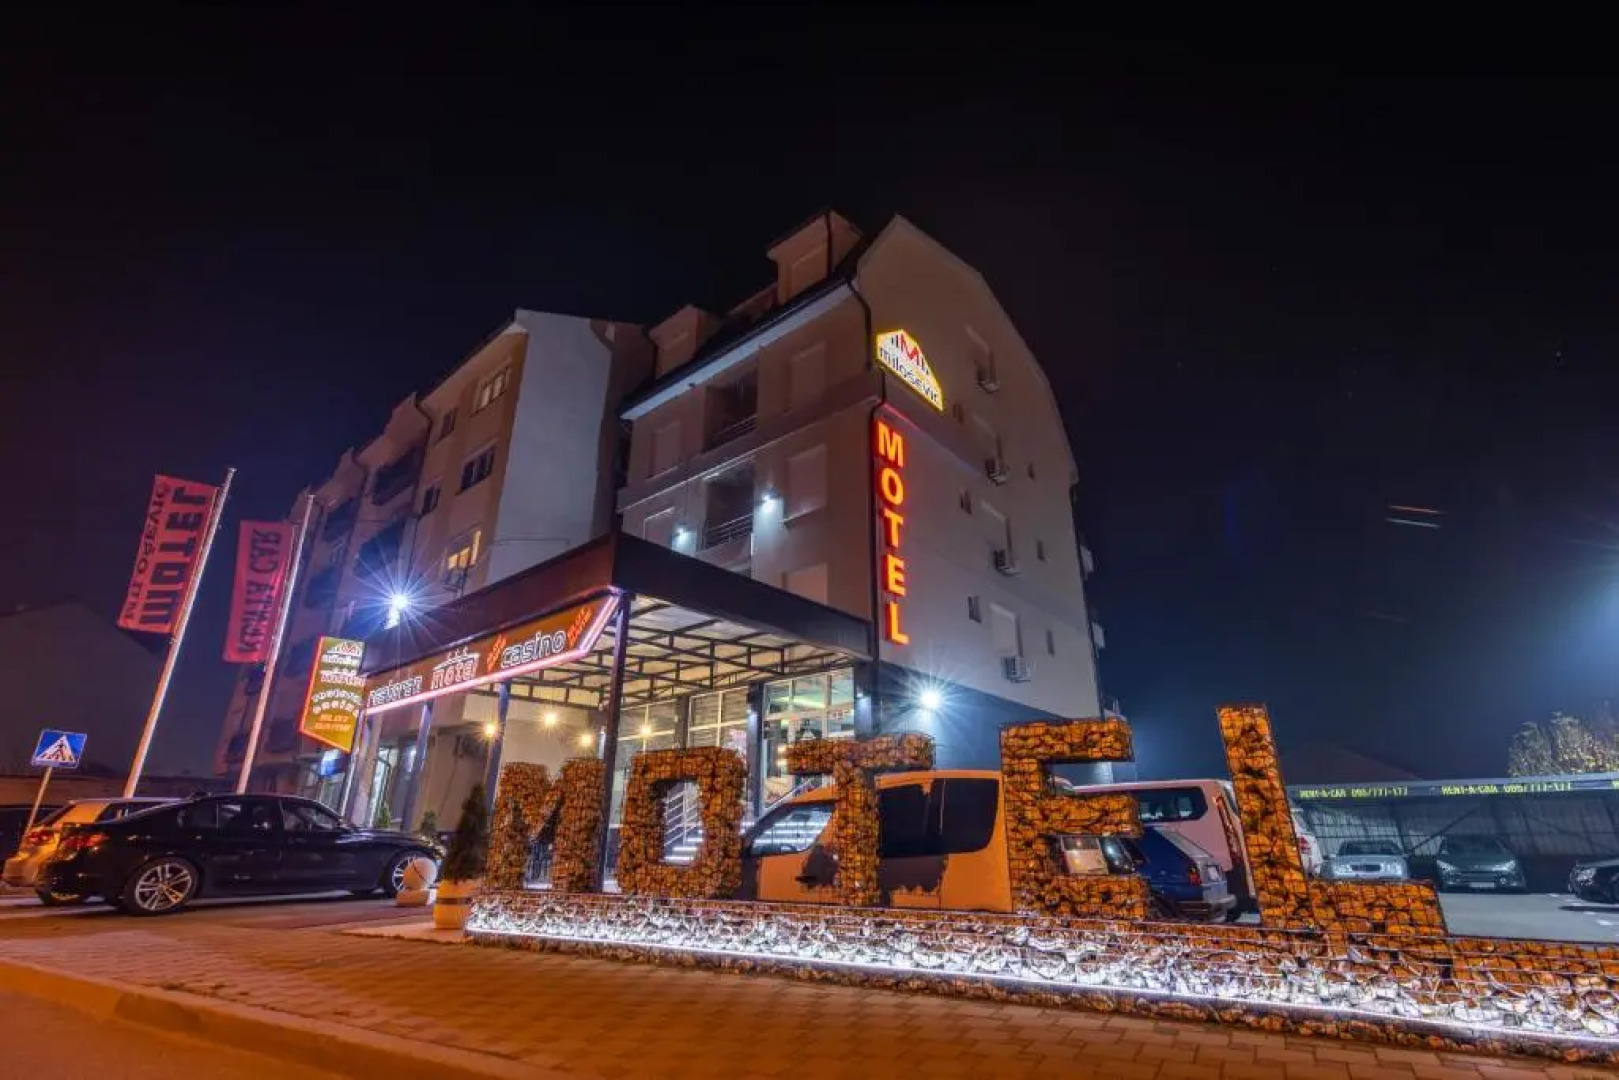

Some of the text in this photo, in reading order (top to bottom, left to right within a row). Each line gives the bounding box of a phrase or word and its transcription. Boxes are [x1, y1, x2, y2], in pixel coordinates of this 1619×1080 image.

[876, 419, 910, 645] MOTEL
[501, 630, 566, 669] casino
[484, 704, 1448, 938] MOTEL
